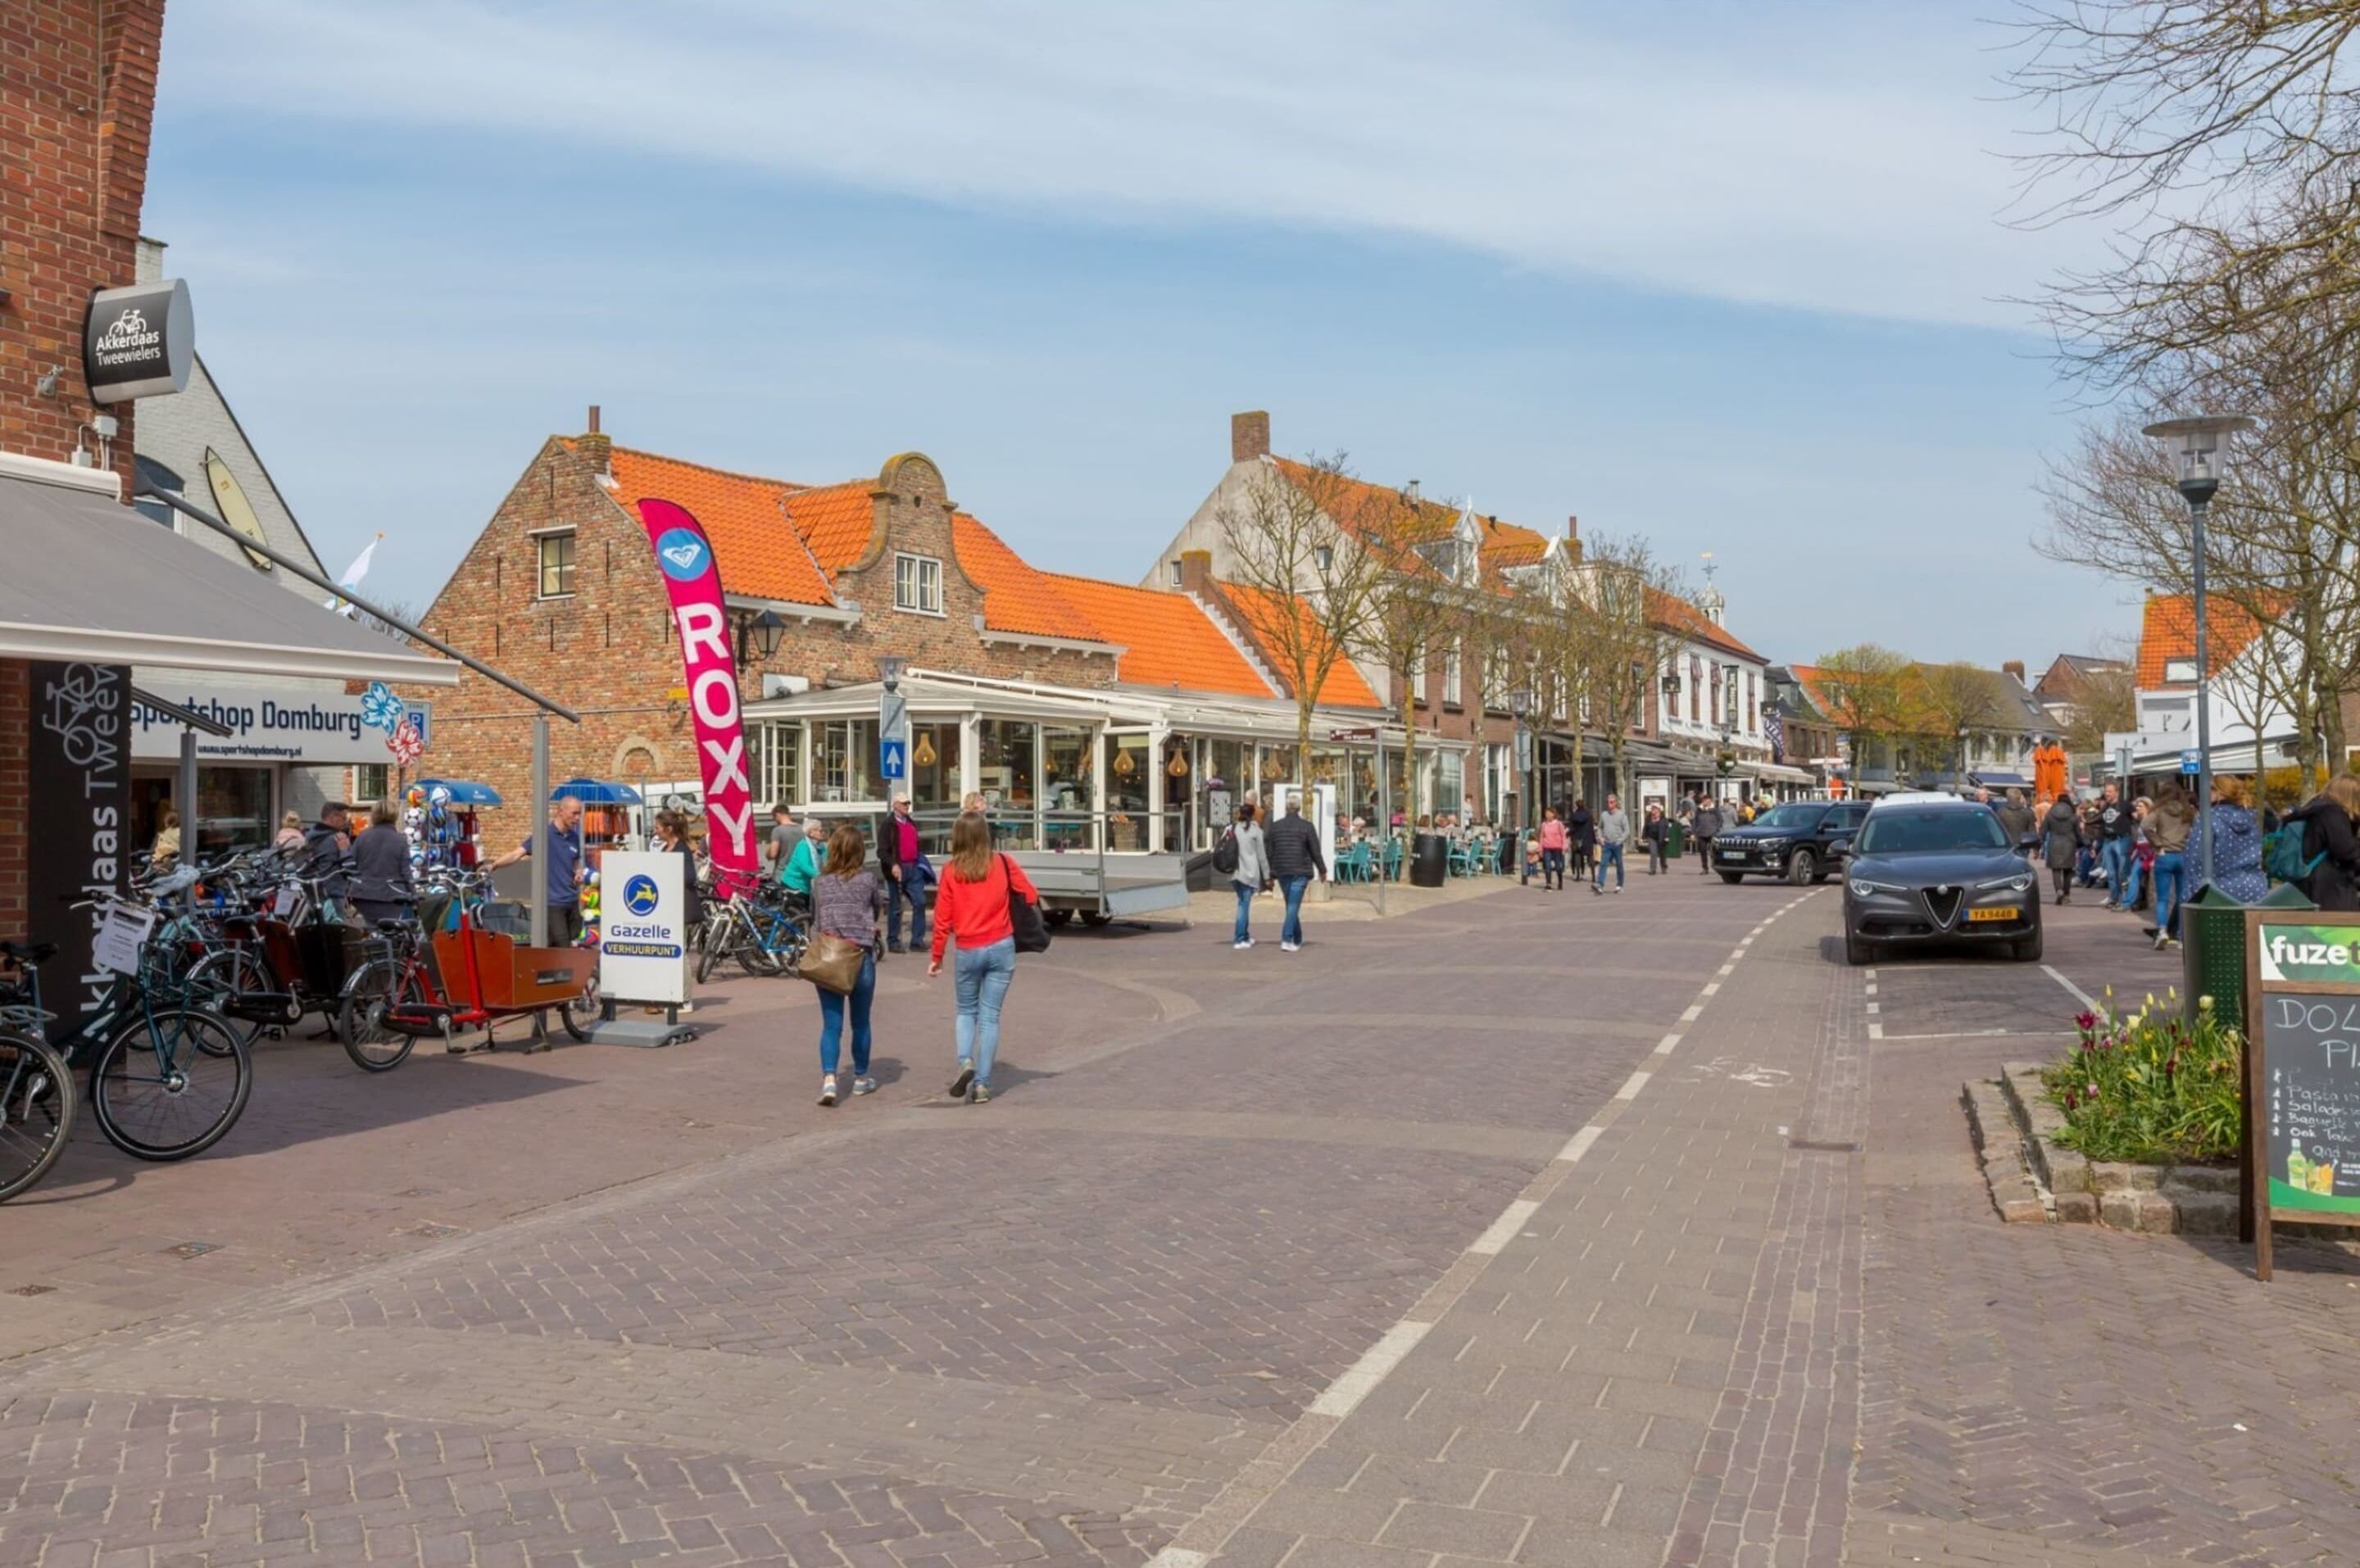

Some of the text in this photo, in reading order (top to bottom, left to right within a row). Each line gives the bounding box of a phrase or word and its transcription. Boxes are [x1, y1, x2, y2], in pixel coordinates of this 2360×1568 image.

[96, 331, 159, 351] Akkerdaas
[96, 346, 161, 366] Tweewielers
[262, 700, 361, 741] Domburg
[676, 601, 752, 857] ROXY
[197, 745, 302, 758] www.sportshopdomburg.nl
[610, 924, 671, 939] Gazelle
[606, 943, 676, 956] VERHUURPUNT
